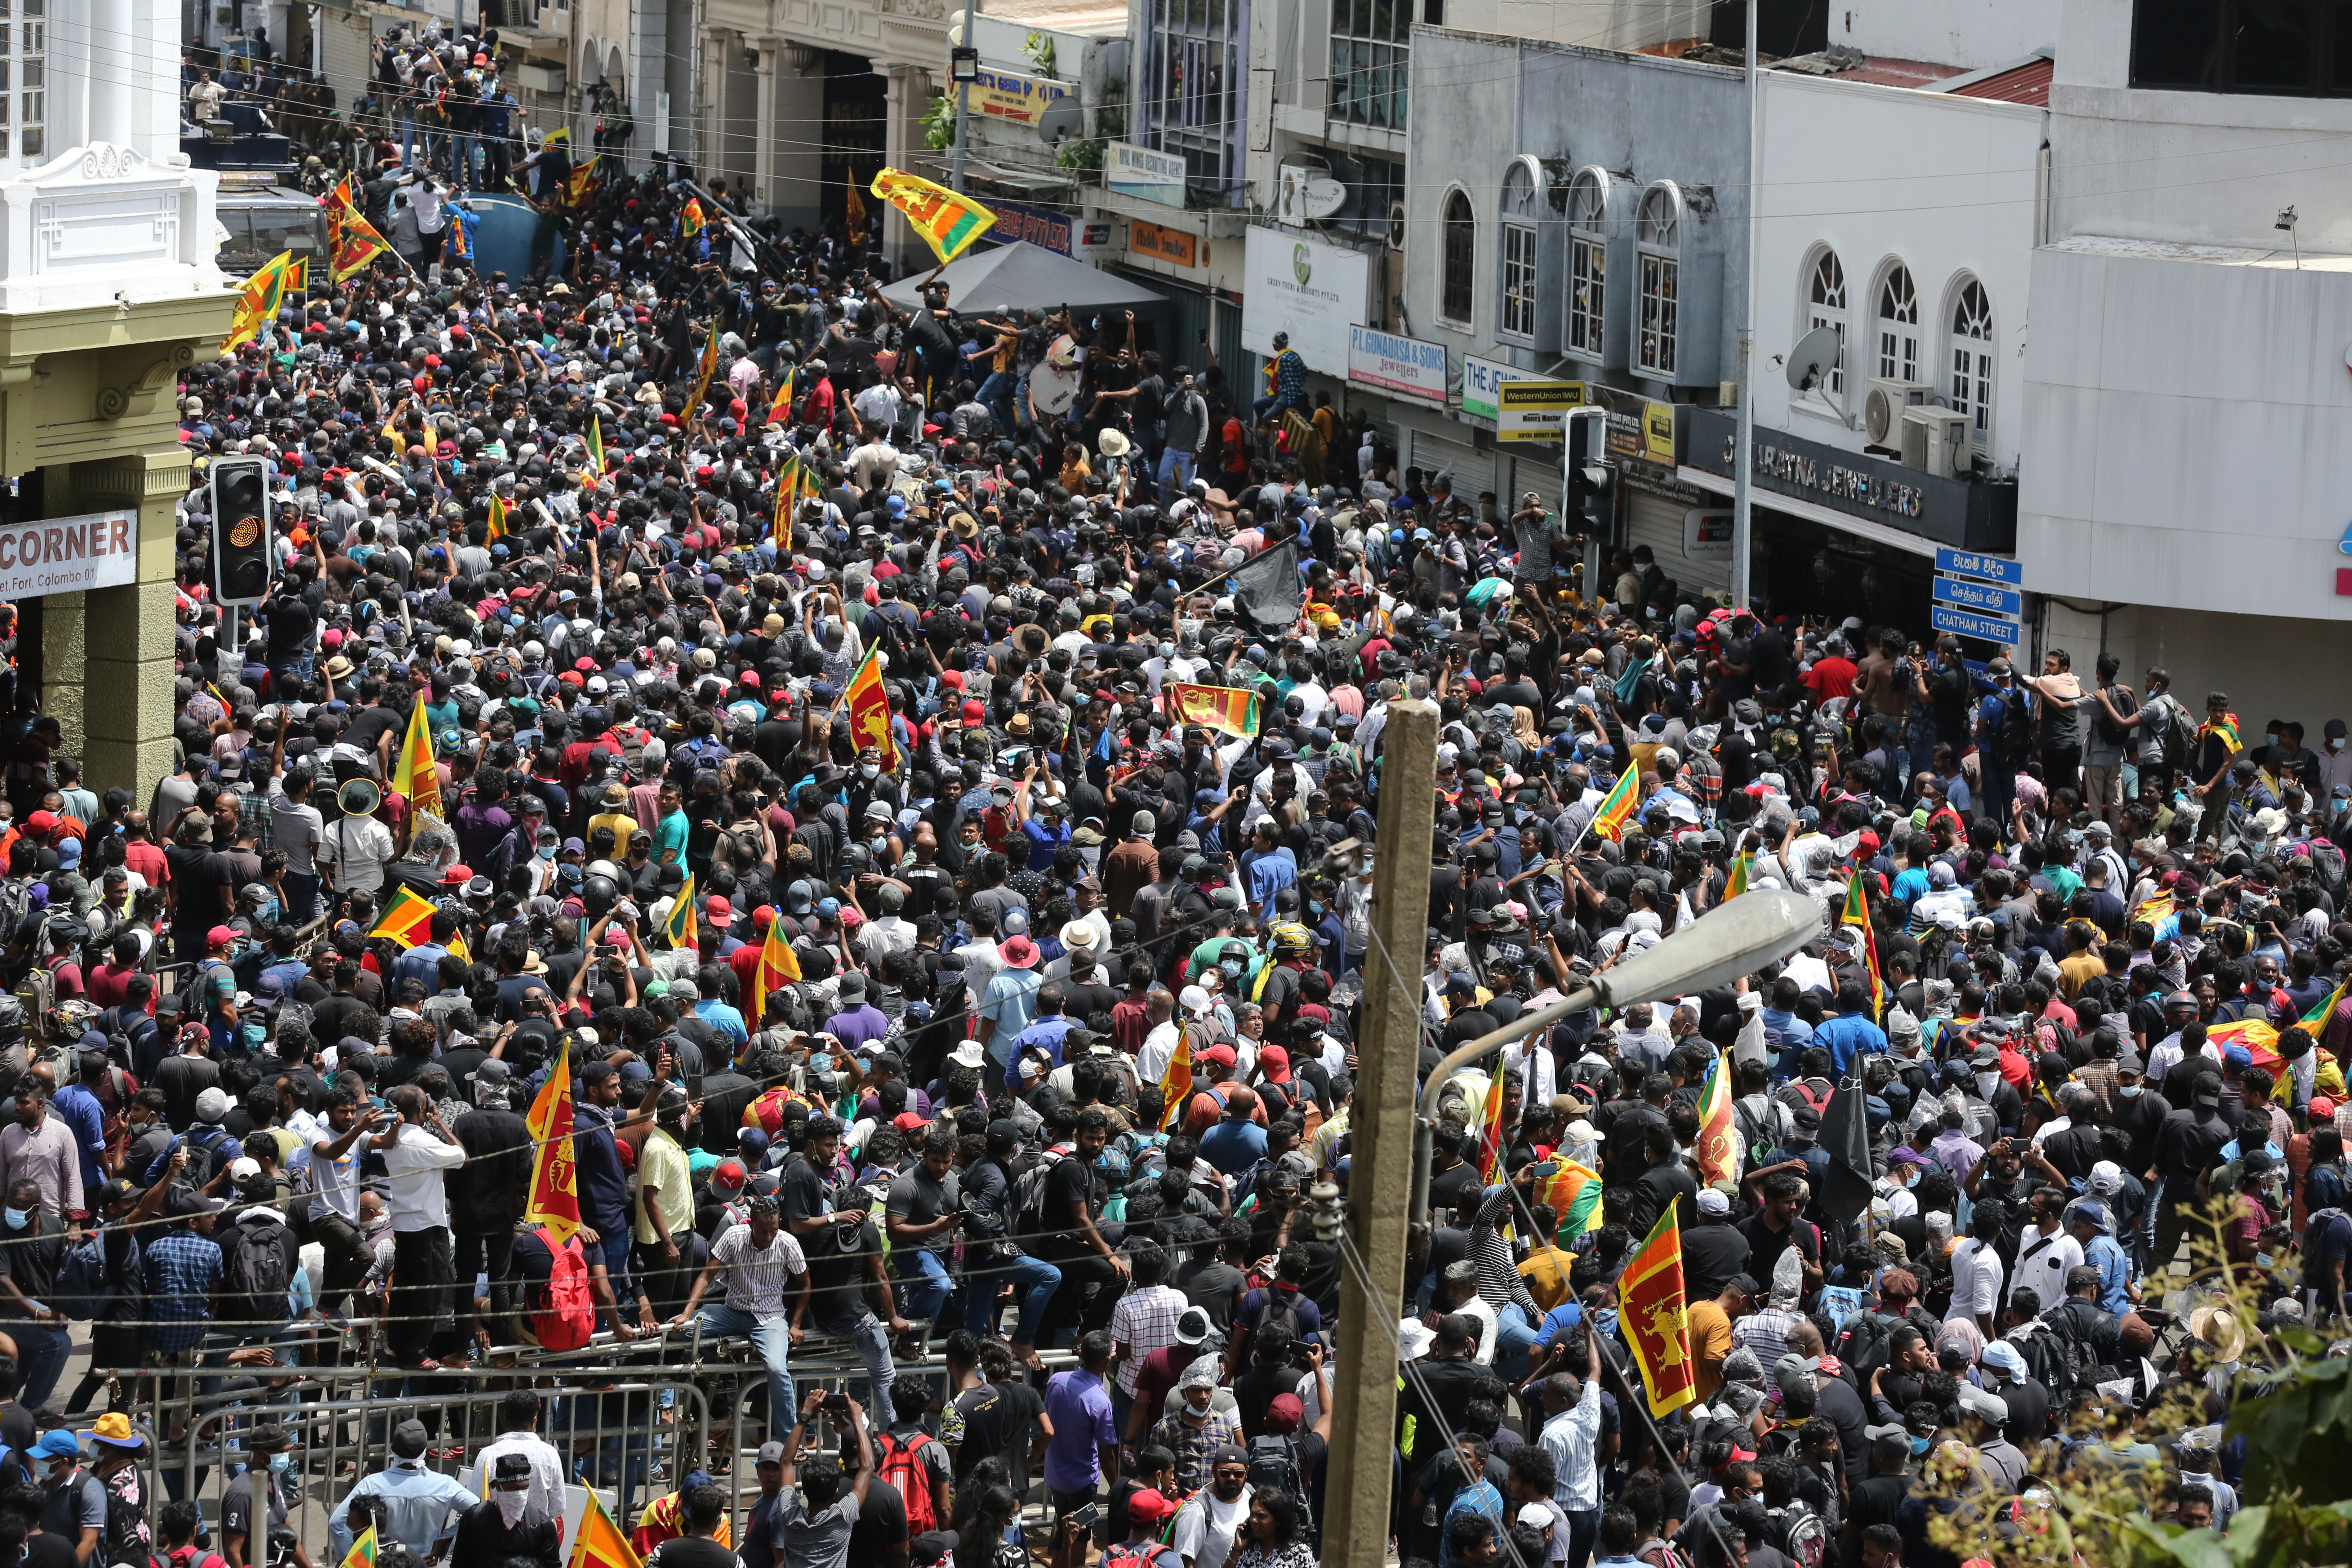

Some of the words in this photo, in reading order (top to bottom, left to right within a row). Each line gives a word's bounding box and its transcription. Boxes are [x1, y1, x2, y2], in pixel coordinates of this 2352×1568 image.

[1306, 192, 1334, 202] Dialog
[995, 207, 1022, 238] GEMS
[1022, 212, 1049, 248] (PVT)
[1267, 277, 1281, 286] GREEN
[1282, 281, 1296, 291] TOURS
[1301, 286, 1320, 297] RESORTS
[1379, 359, 1419, 378] Jewellers
[1412, 345, 1418, 364] &
[1420, 345, 1444, 372] SONS
[1467, 362, 1487, 391] THE
[1822, 464, 1923, 517] JEWELLERS
[0, 519, 129, 570] CORNER
[12, 577, 34, 590] Fort,
[38, 571, 81, 586] Colombo
[1951, 584, 1983, 603] செத்தம்
[1986, 592, 2002, 608] வீதி
[1937, 612, 1978, 632] CHATHAM
[1980, 621, 2013, 639] STREET
[565, 801, 570, 813] 3
[907, 870, 938, 878] #GOTAGOHOME
[1933, 1275, 1953, 1287] SUPE
